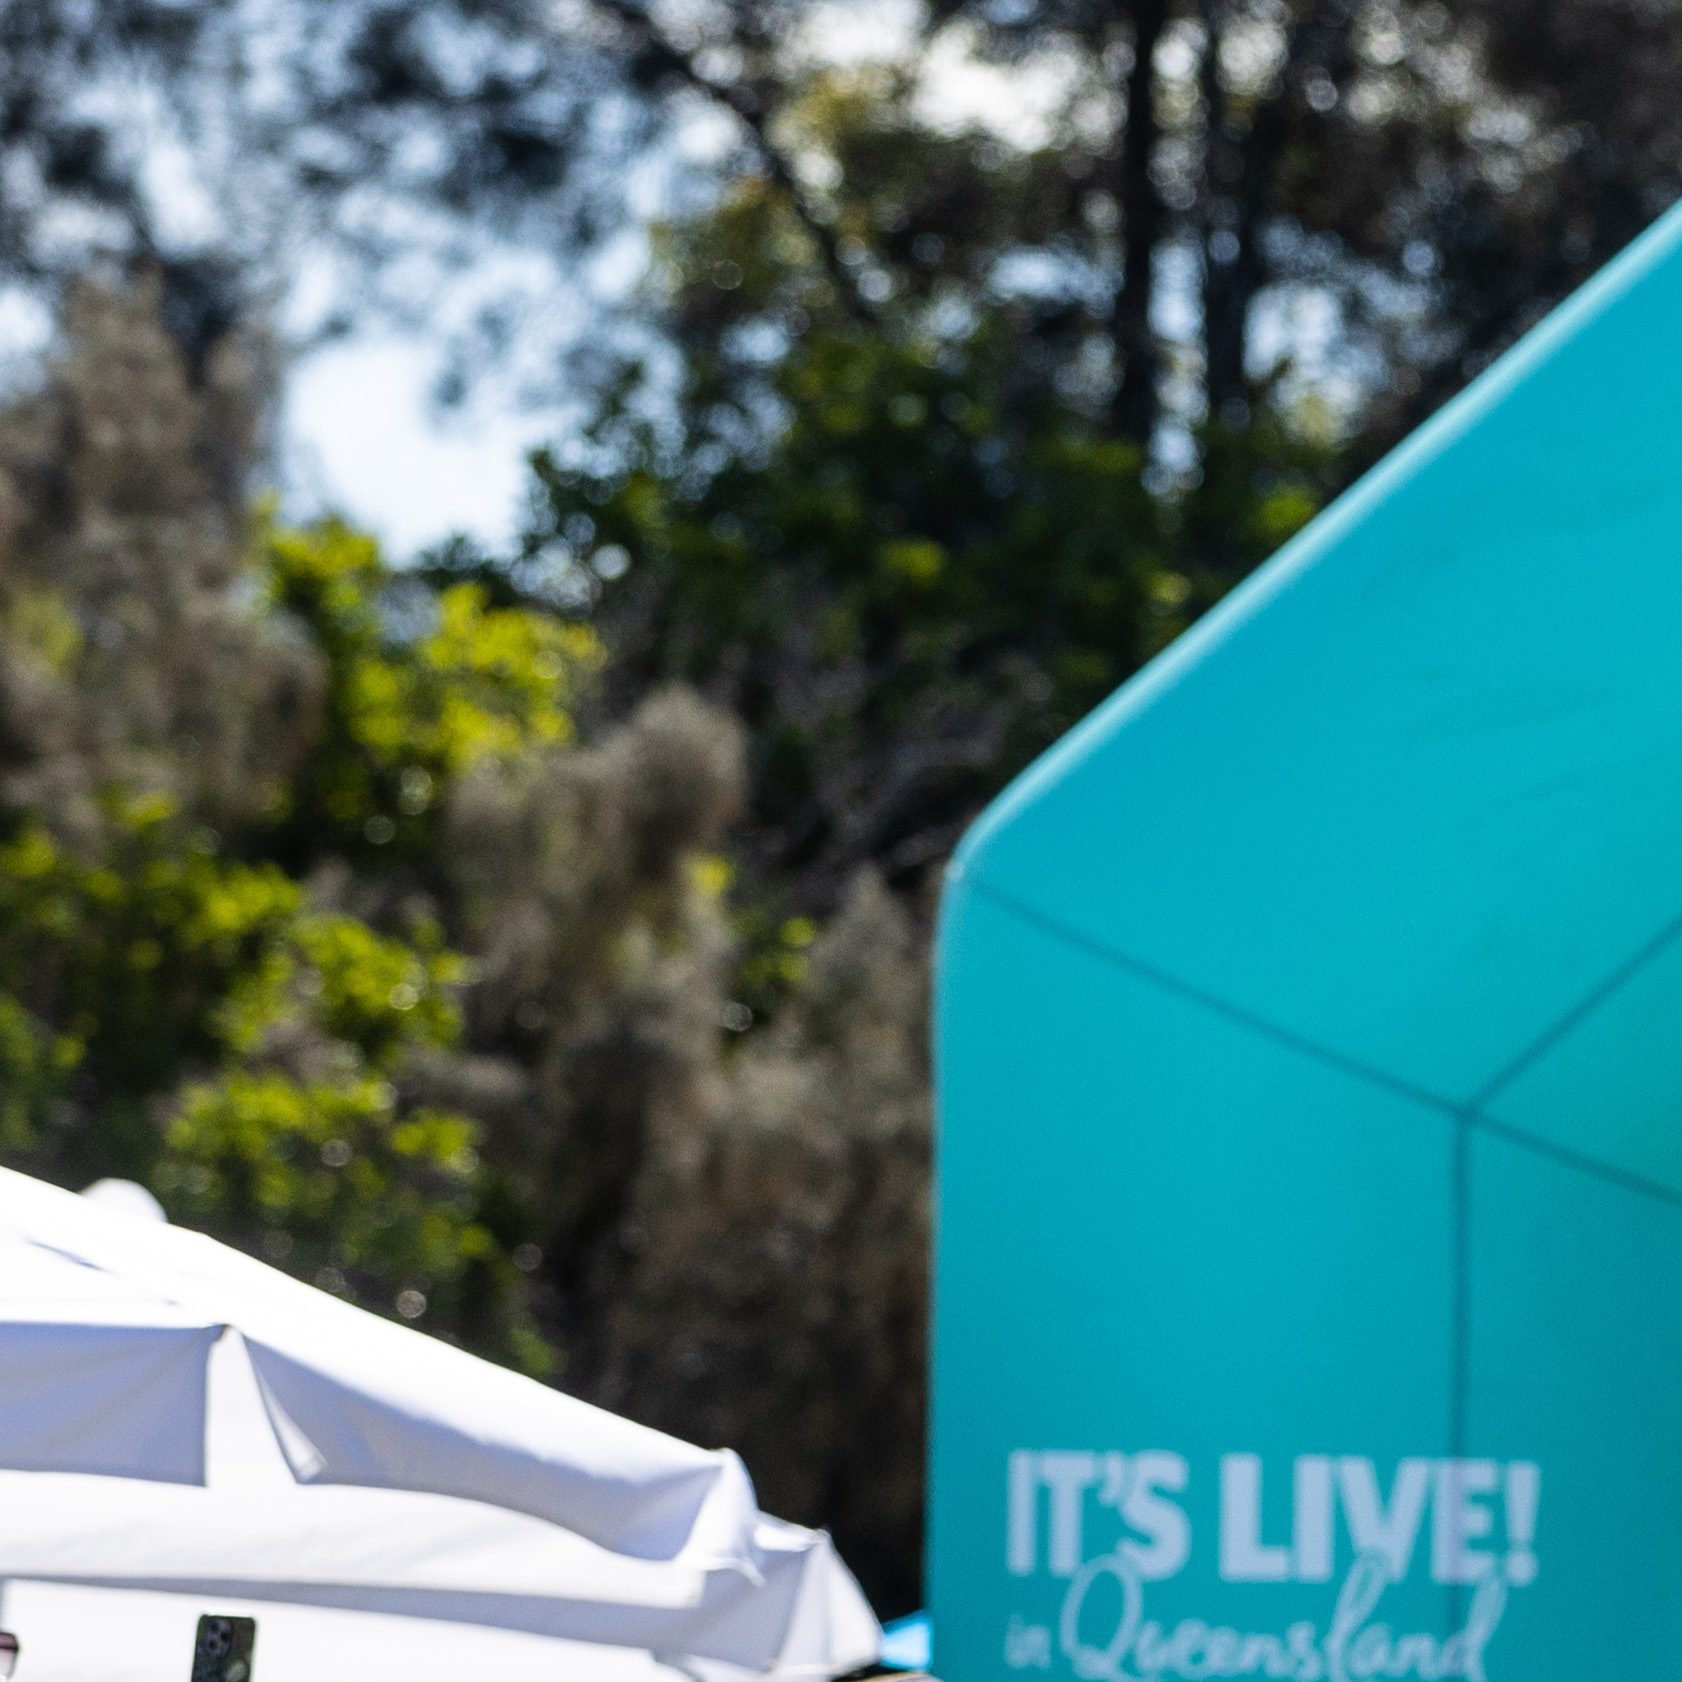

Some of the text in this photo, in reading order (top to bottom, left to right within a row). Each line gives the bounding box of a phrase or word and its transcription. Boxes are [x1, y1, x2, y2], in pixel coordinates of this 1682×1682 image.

[1005, 1450, 1540, 1585] IT'S LIVE!
[1003, 1610, 1050, 1670] in
